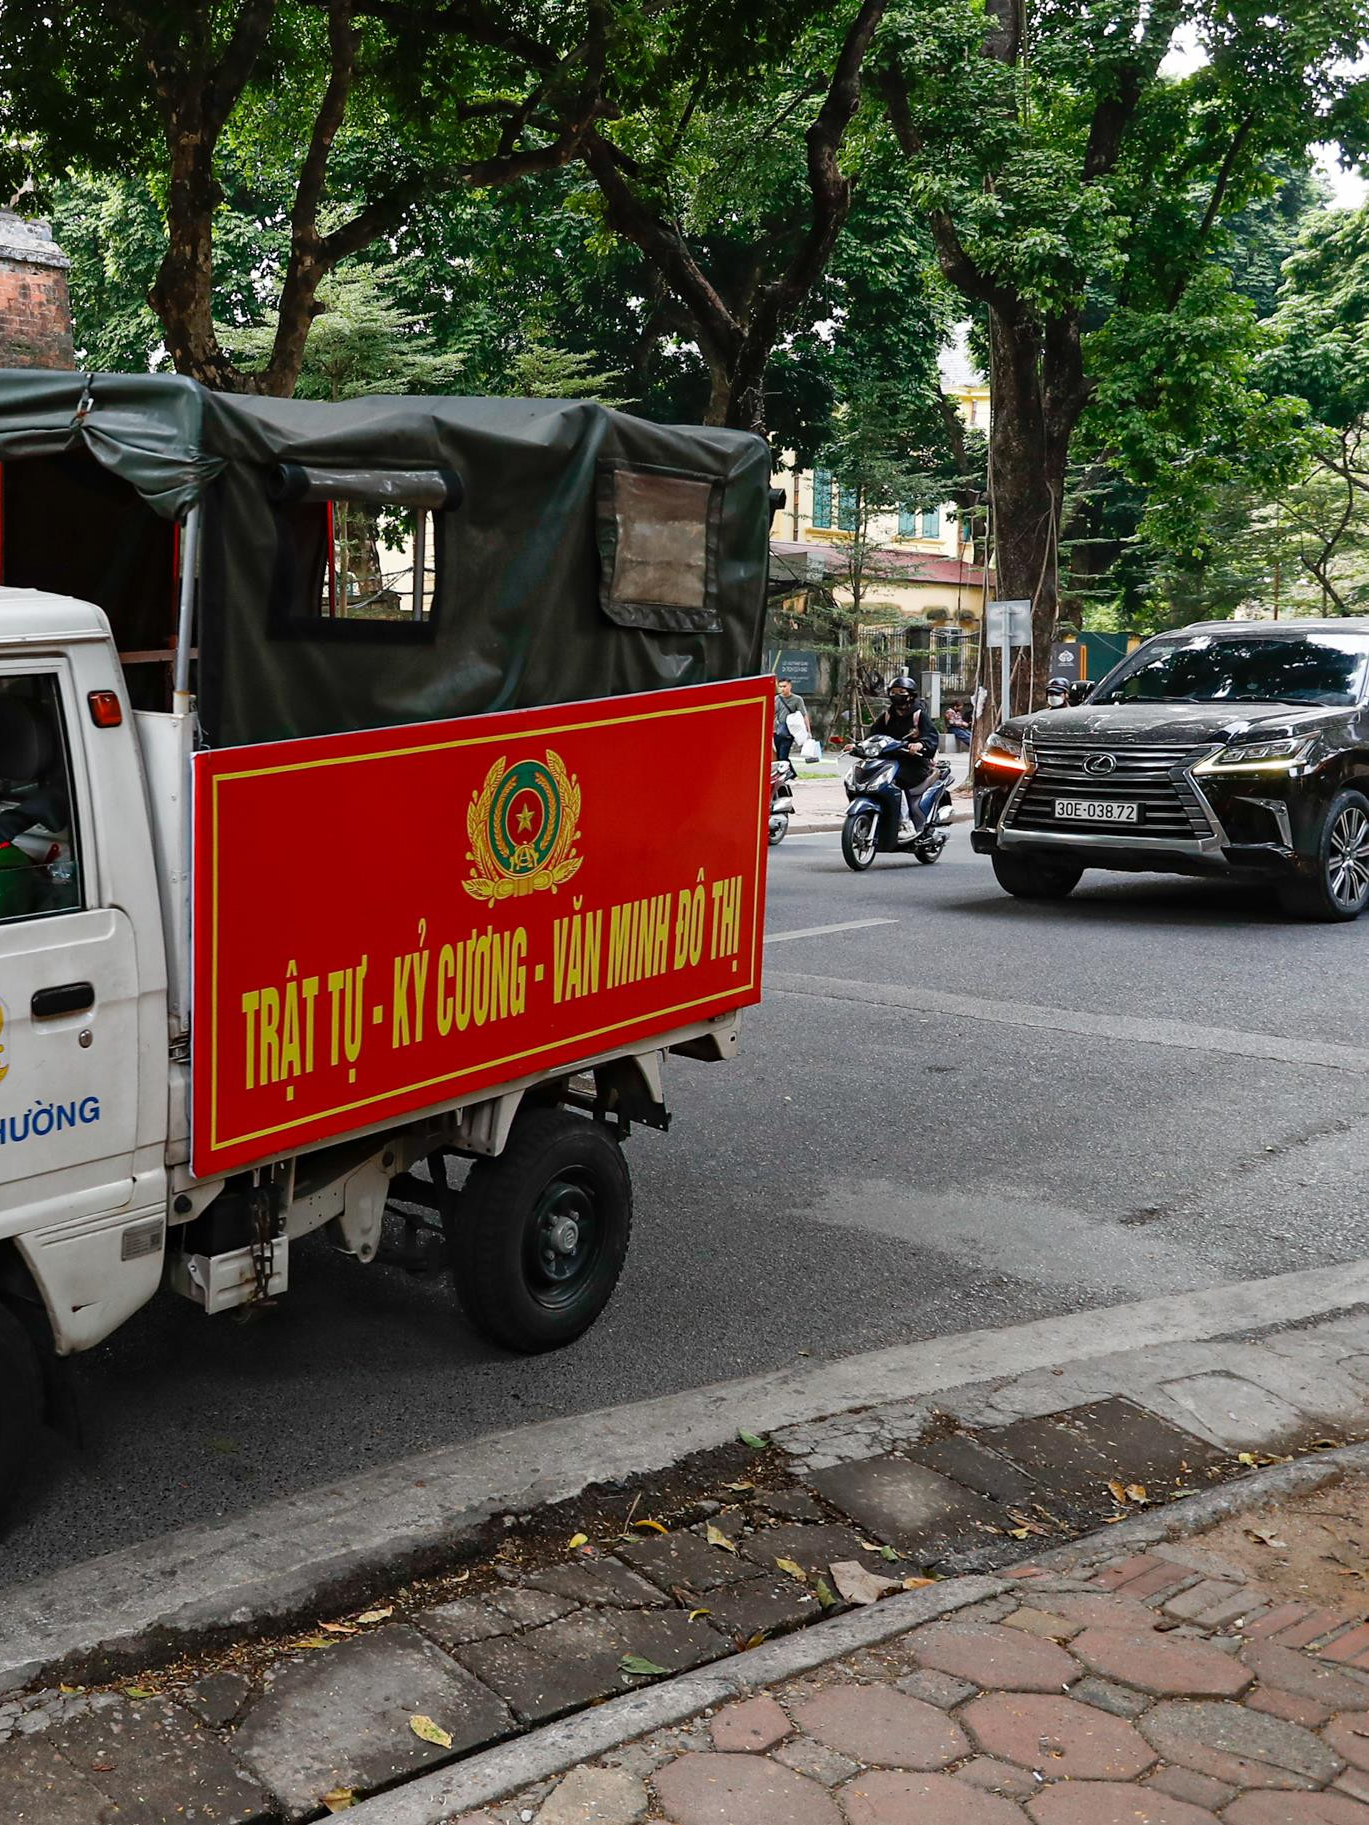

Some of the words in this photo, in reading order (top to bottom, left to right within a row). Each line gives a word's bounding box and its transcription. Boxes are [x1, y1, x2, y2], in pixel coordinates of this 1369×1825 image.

[1057, 802, 1135, 820] 30E-038.72
[242, 959, 319, 1101] TRẬT
[328, 954, 368, 1083] TỰ
[392, 918, 429, 1049] KỶ
[436, 925, 527, 1036] CƯƠNG
[553, 895, 603, 1004] VĂN
[606, 893, 672, 989] MINH
[673, 867, 705, 970] ĐÔ
[710, 875, 742, 972] THỊ
